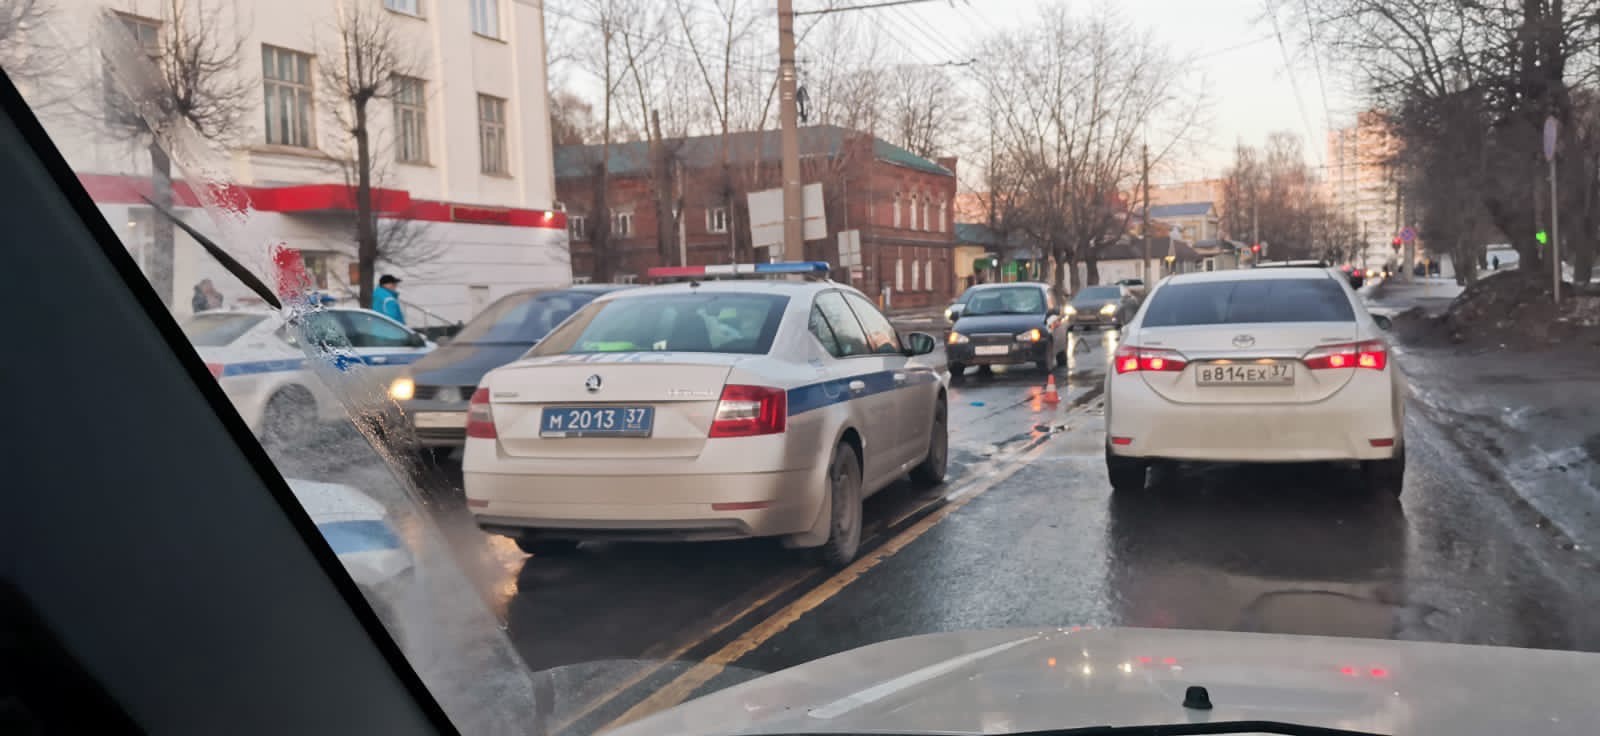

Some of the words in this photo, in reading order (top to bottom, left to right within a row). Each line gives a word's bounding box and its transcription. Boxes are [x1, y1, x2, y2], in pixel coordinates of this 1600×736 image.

[1202, 366, 1266, 381] В814ЕХ
[1272, 364, 1287, 377] 37
[567, 409, 616, 429] 2013
[626, 408, 645, 423] 37
